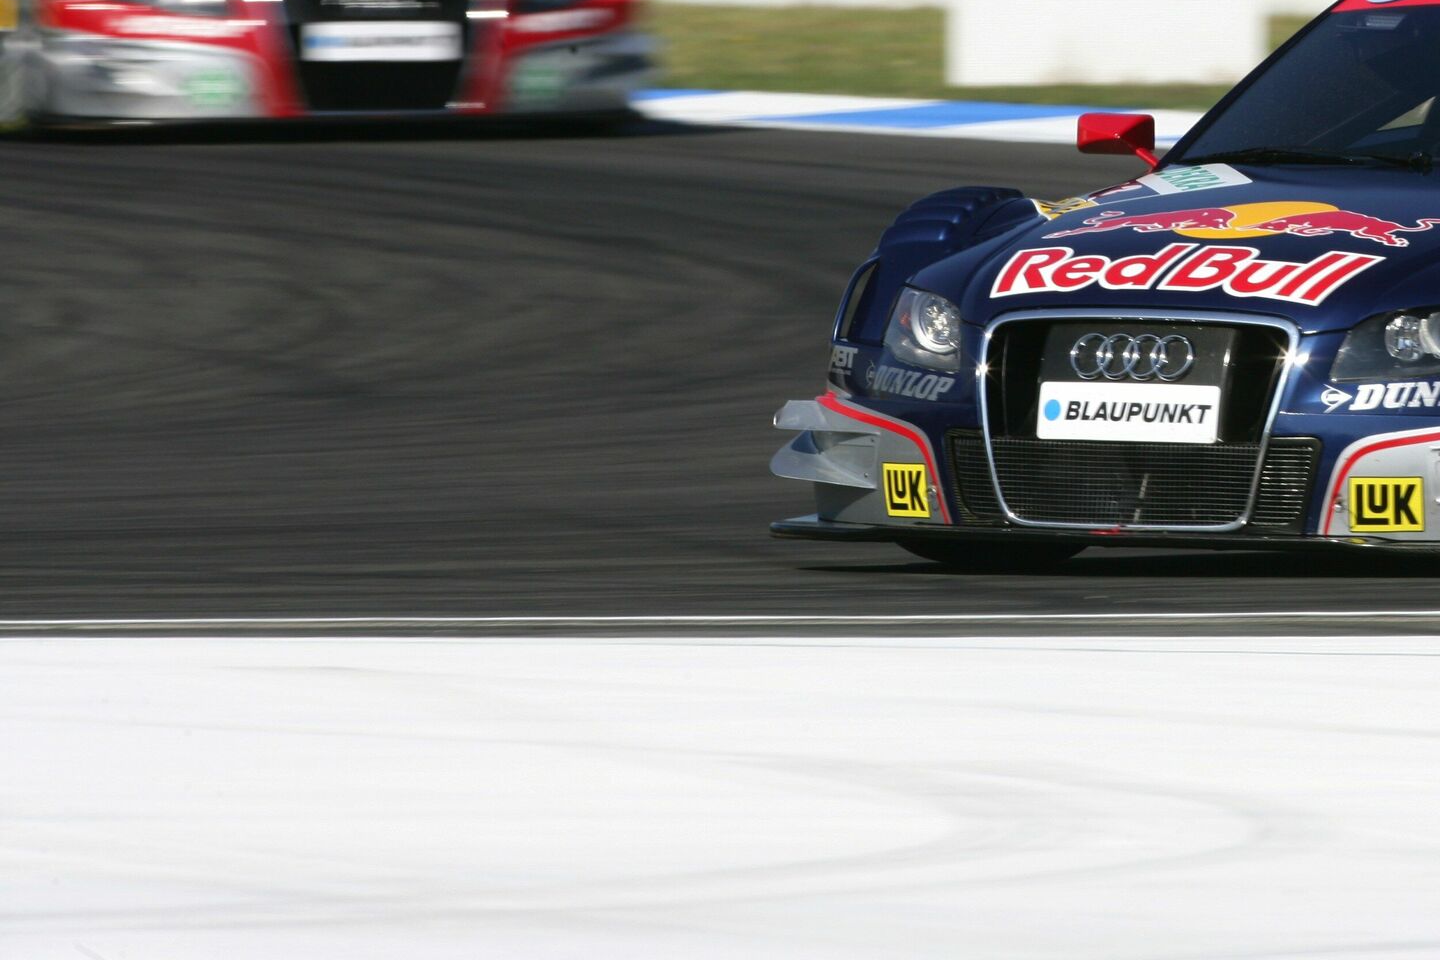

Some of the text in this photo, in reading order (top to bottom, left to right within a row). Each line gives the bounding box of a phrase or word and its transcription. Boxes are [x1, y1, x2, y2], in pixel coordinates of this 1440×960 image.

[829, 345, 858, 371] ABT
[873, 365, 955, 401] DUNLOP
[1065, 401, 1211, 424] BLAUPUNKT
